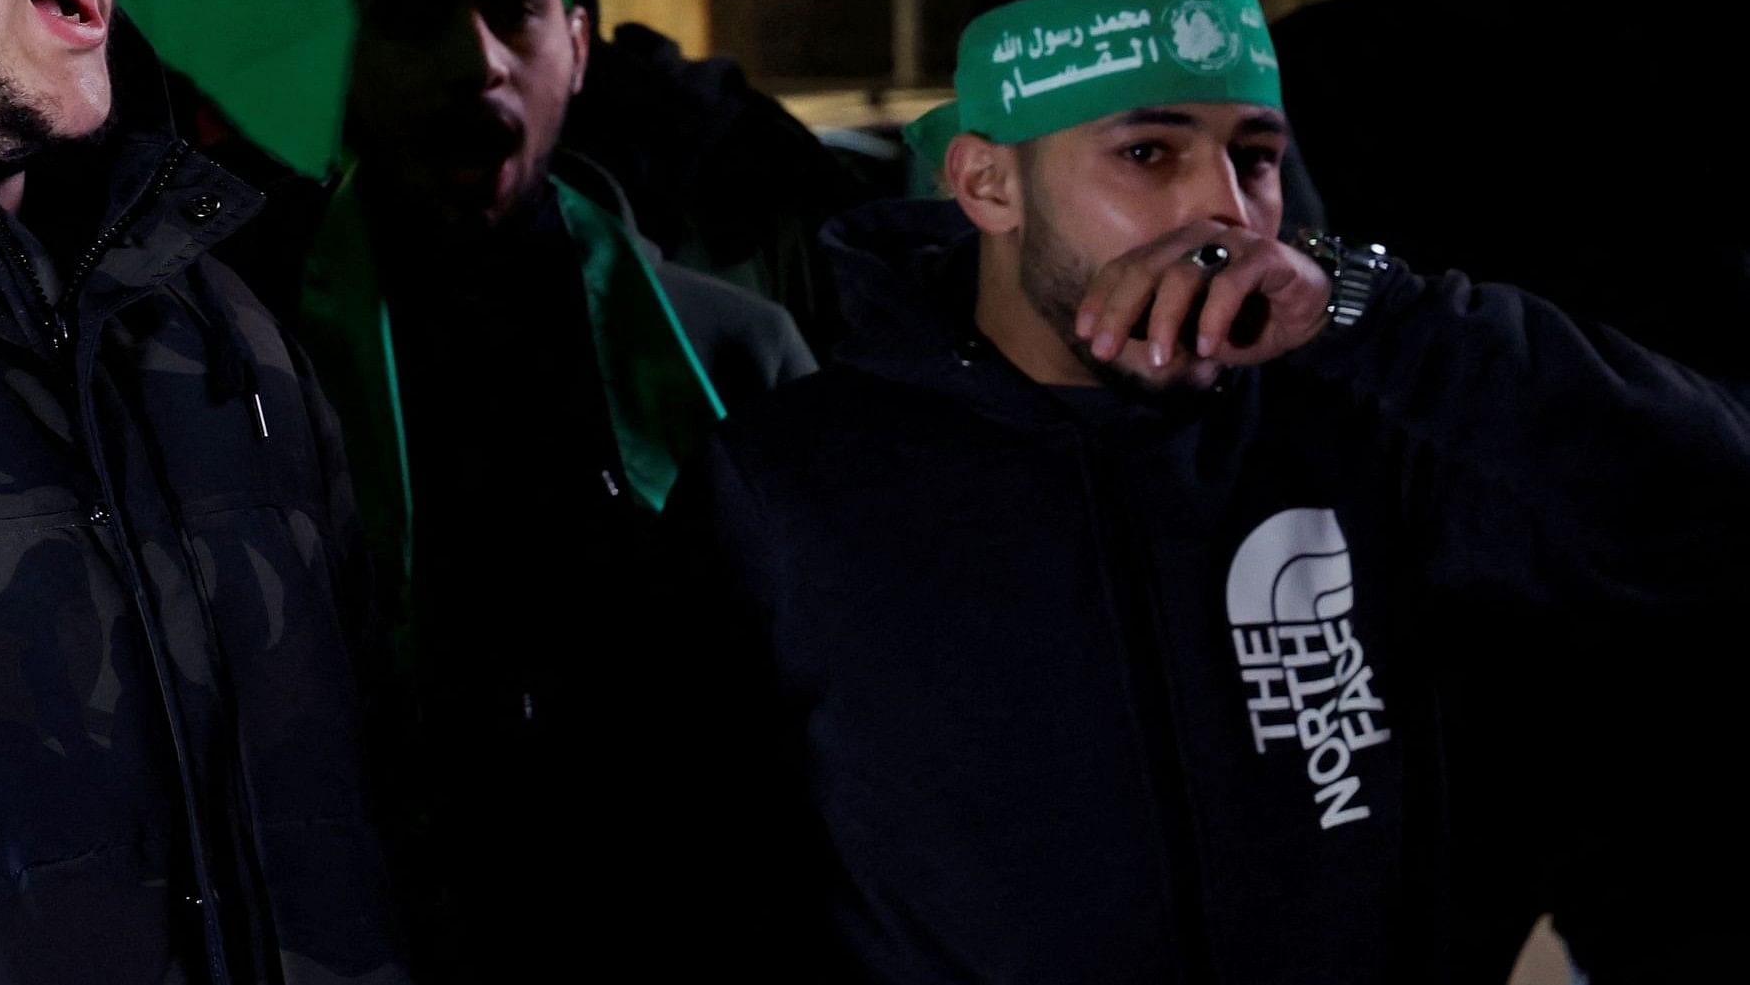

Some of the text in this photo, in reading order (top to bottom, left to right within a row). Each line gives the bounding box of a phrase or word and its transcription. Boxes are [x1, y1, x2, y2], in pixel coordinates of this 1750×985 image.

[992, 9, 1151, 63] محمد رسول الله
[1000, 36, 1159, 115] القسام
[1232, 626, 1298, 754] THE
[1278, 624, 1371, 830] NORTH
[1322, 618, 1391, 751] FACE
